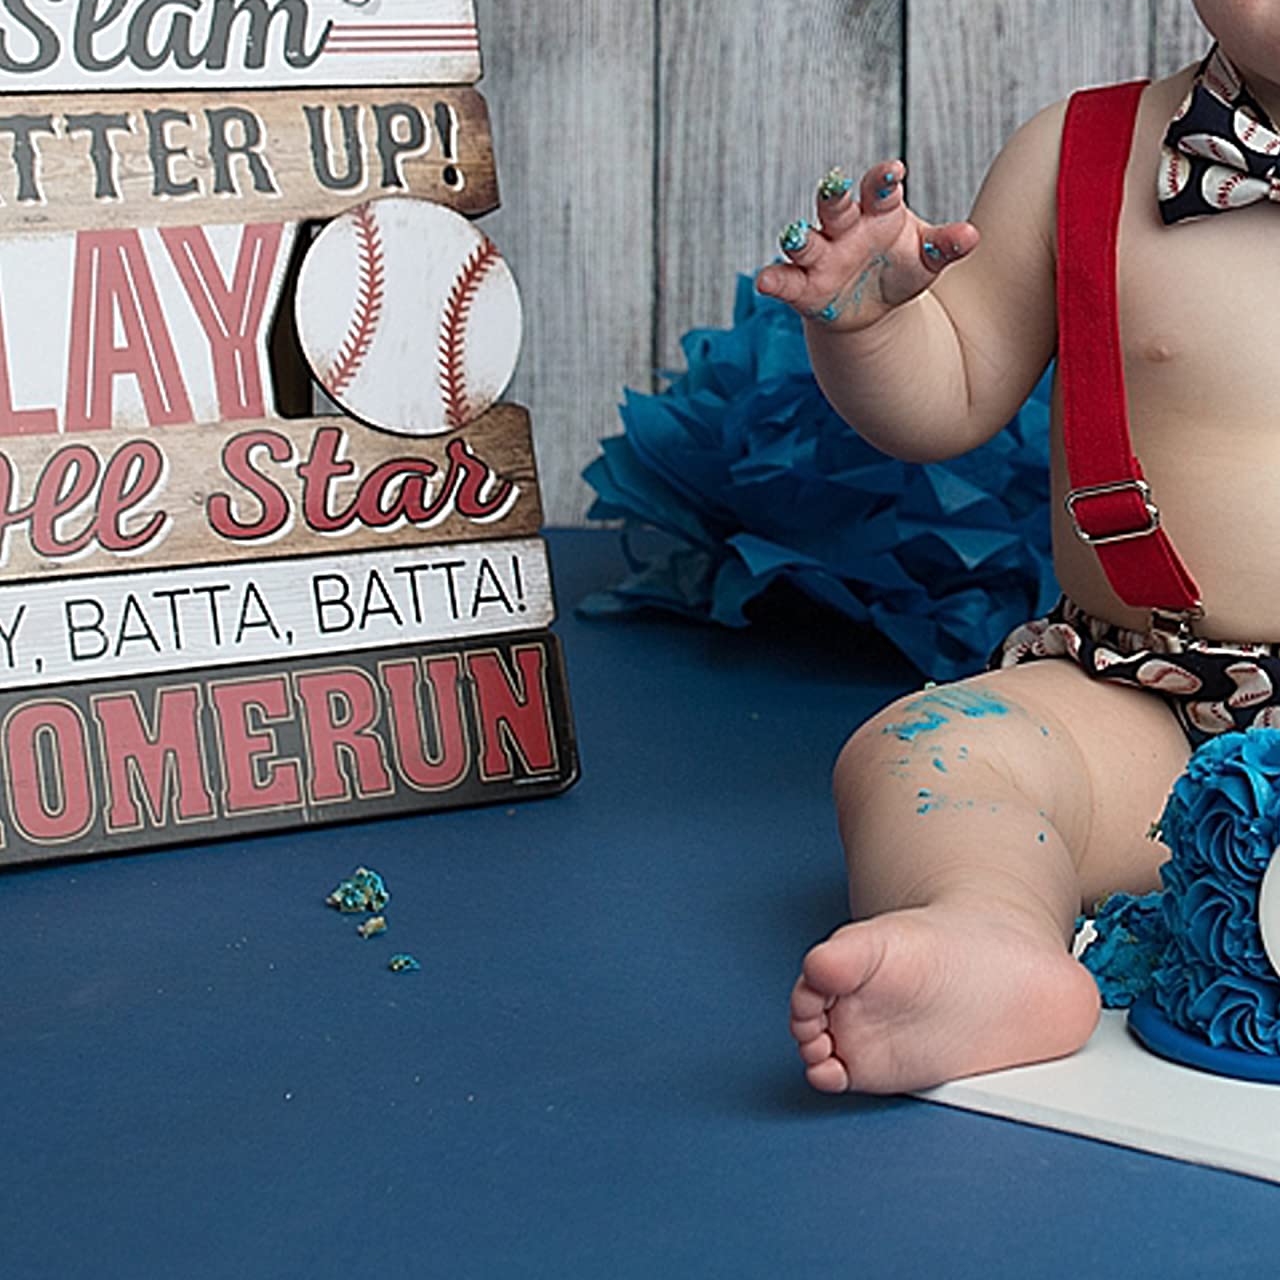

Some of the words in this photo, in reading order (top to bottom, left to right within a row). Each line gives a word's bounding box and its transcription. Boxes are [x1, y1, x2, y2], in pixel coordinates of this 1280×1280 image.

[303, 103, 463, 200] UP!
[207, 428, 512, 541] Star
[66, 582, 294, 662] BATTA,
[313, 555, 527, 633] BATTA!
[0, 642, 562, 848] OMERUN
